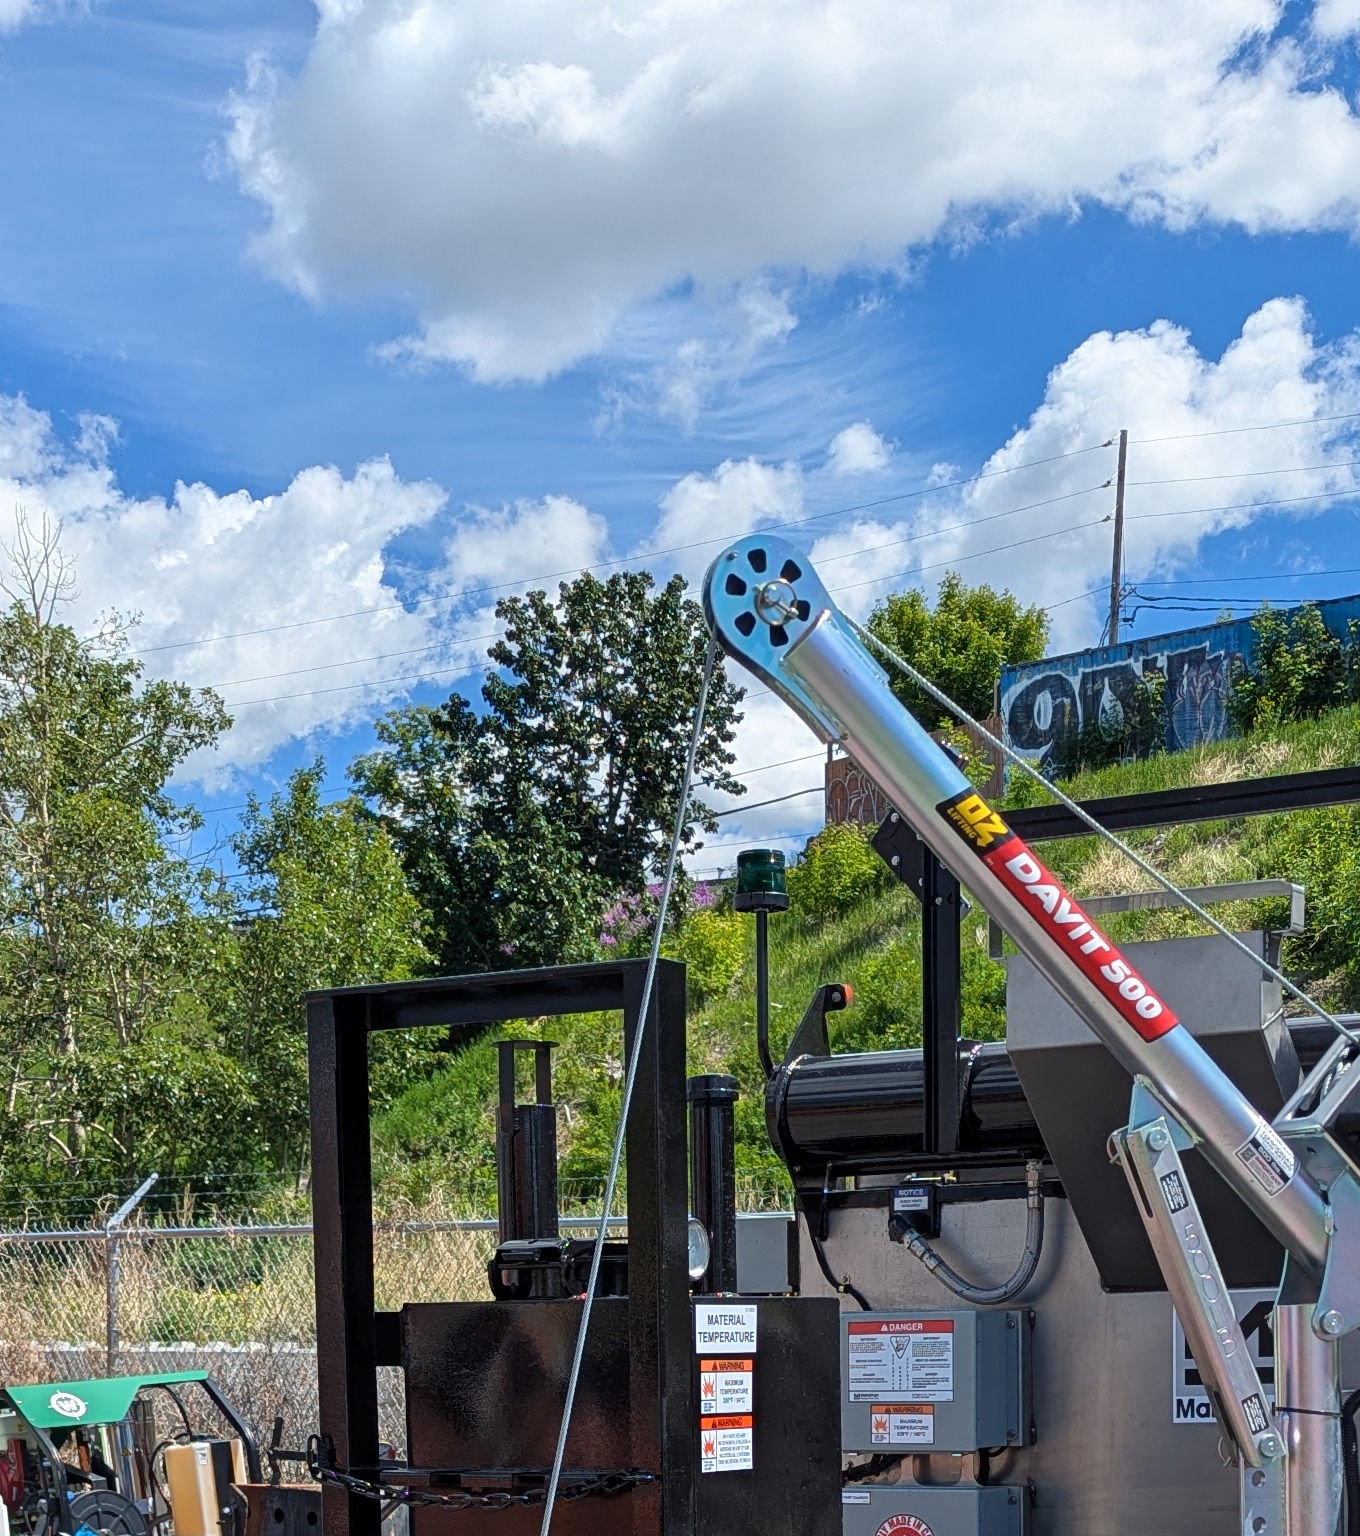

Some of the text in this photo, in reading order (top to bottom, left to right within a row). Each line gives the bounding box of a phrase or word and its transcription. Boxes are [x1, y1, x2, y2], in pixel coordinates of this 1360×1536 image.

[946, 807, 978, 840] LIFTING
[1005, 852, 1163, 1019] DAVIT 500
[898, 1188, 924, 1196] NOTICE
[707, 1314, 746, 1326] MATERIAL
[889, 1323, 923, 1331] DANGER
[698, 1331, 755, 1343] TEMPERATURE
[718, 1361, 745, 1371] WARNING
[717, 1418, 743, 1428] WARNING
[887, 1515, 912, 1529] MADE
[912, 1517, 923, 1531] IN
